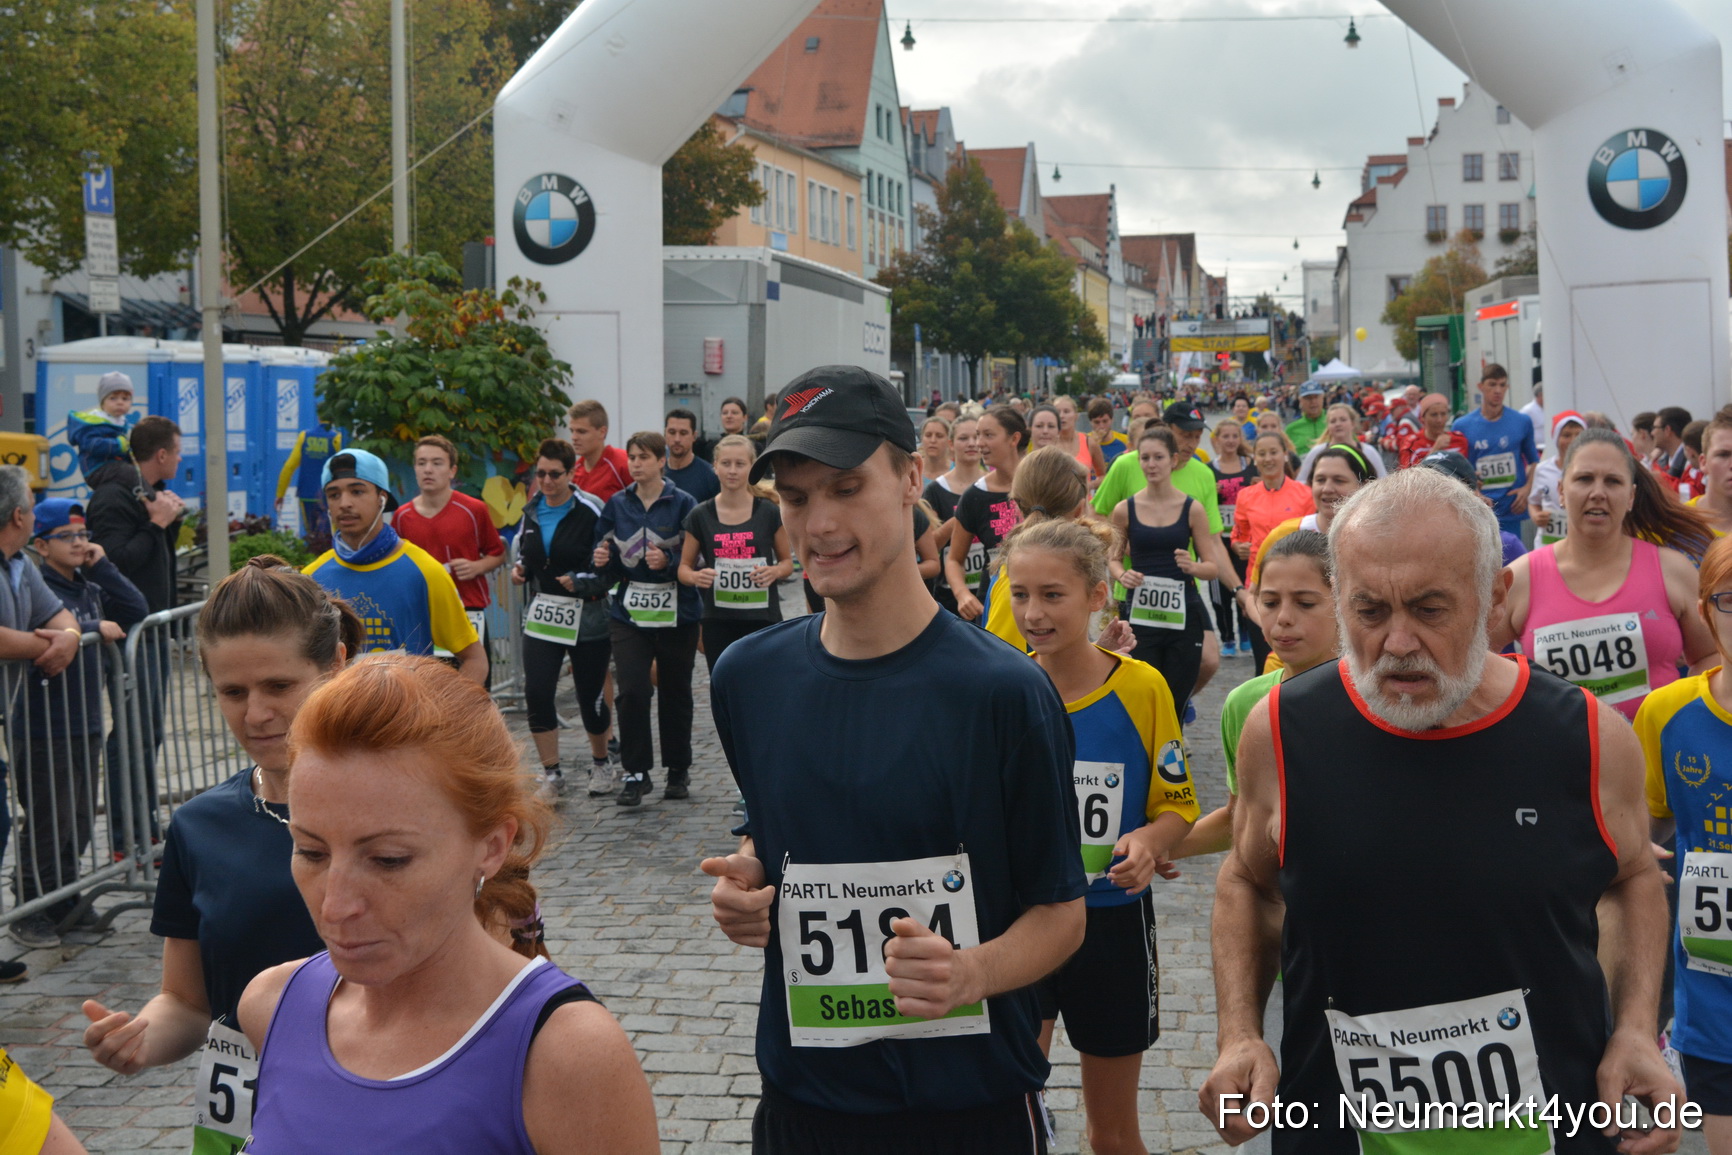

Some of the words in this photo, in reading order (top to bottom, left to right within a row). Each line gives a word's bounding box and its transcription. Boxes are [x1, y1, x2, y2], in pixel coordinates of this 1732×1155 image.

[1595, 130, 1681, 166] BMW
[517, 174, 589, 206] BMW
[26, 338, 35, 359] 3
[1202, 339, 1237, 349] START
[800, 387, 835, 413] YOKOHAMA
[1474, 439, 1489, 450] AS
[1481, 461, 1512, 478] 5161
[720, 570, 763, 589] 505
[629, 591, 672, 608] 5552
[1138, 588, 1181, 609] 5005
[534, 603, 575, 627] 5553
[1147, 611, 1168, 621] Linda
[1536, 632, 1569, 646] PARTL
[1571, 623, 1622, 640] Neumarkt
[1547, 636, 1637, 679] 5048
[1682, 765, 1703, 775] Jahre
[1688, 756, 1697, 764] 15
[1685, 865, 1729, 879] PARTL
[782, 883, 838, 899] PARTL
[842, 878, 935, 899] Neumarkt
[1686, 926, 1692, 936] S
[791, 971, 798, 983] S
[819, 994, 905, 1021] Sebas
[1333, 1027, 1386, 1049] PARTL
[1390, 1017, 1490, 1048] Neumarkt
[206, 1037, 251, 1061] ARTL
[1349, 1042, 1521, 1123] 5500
